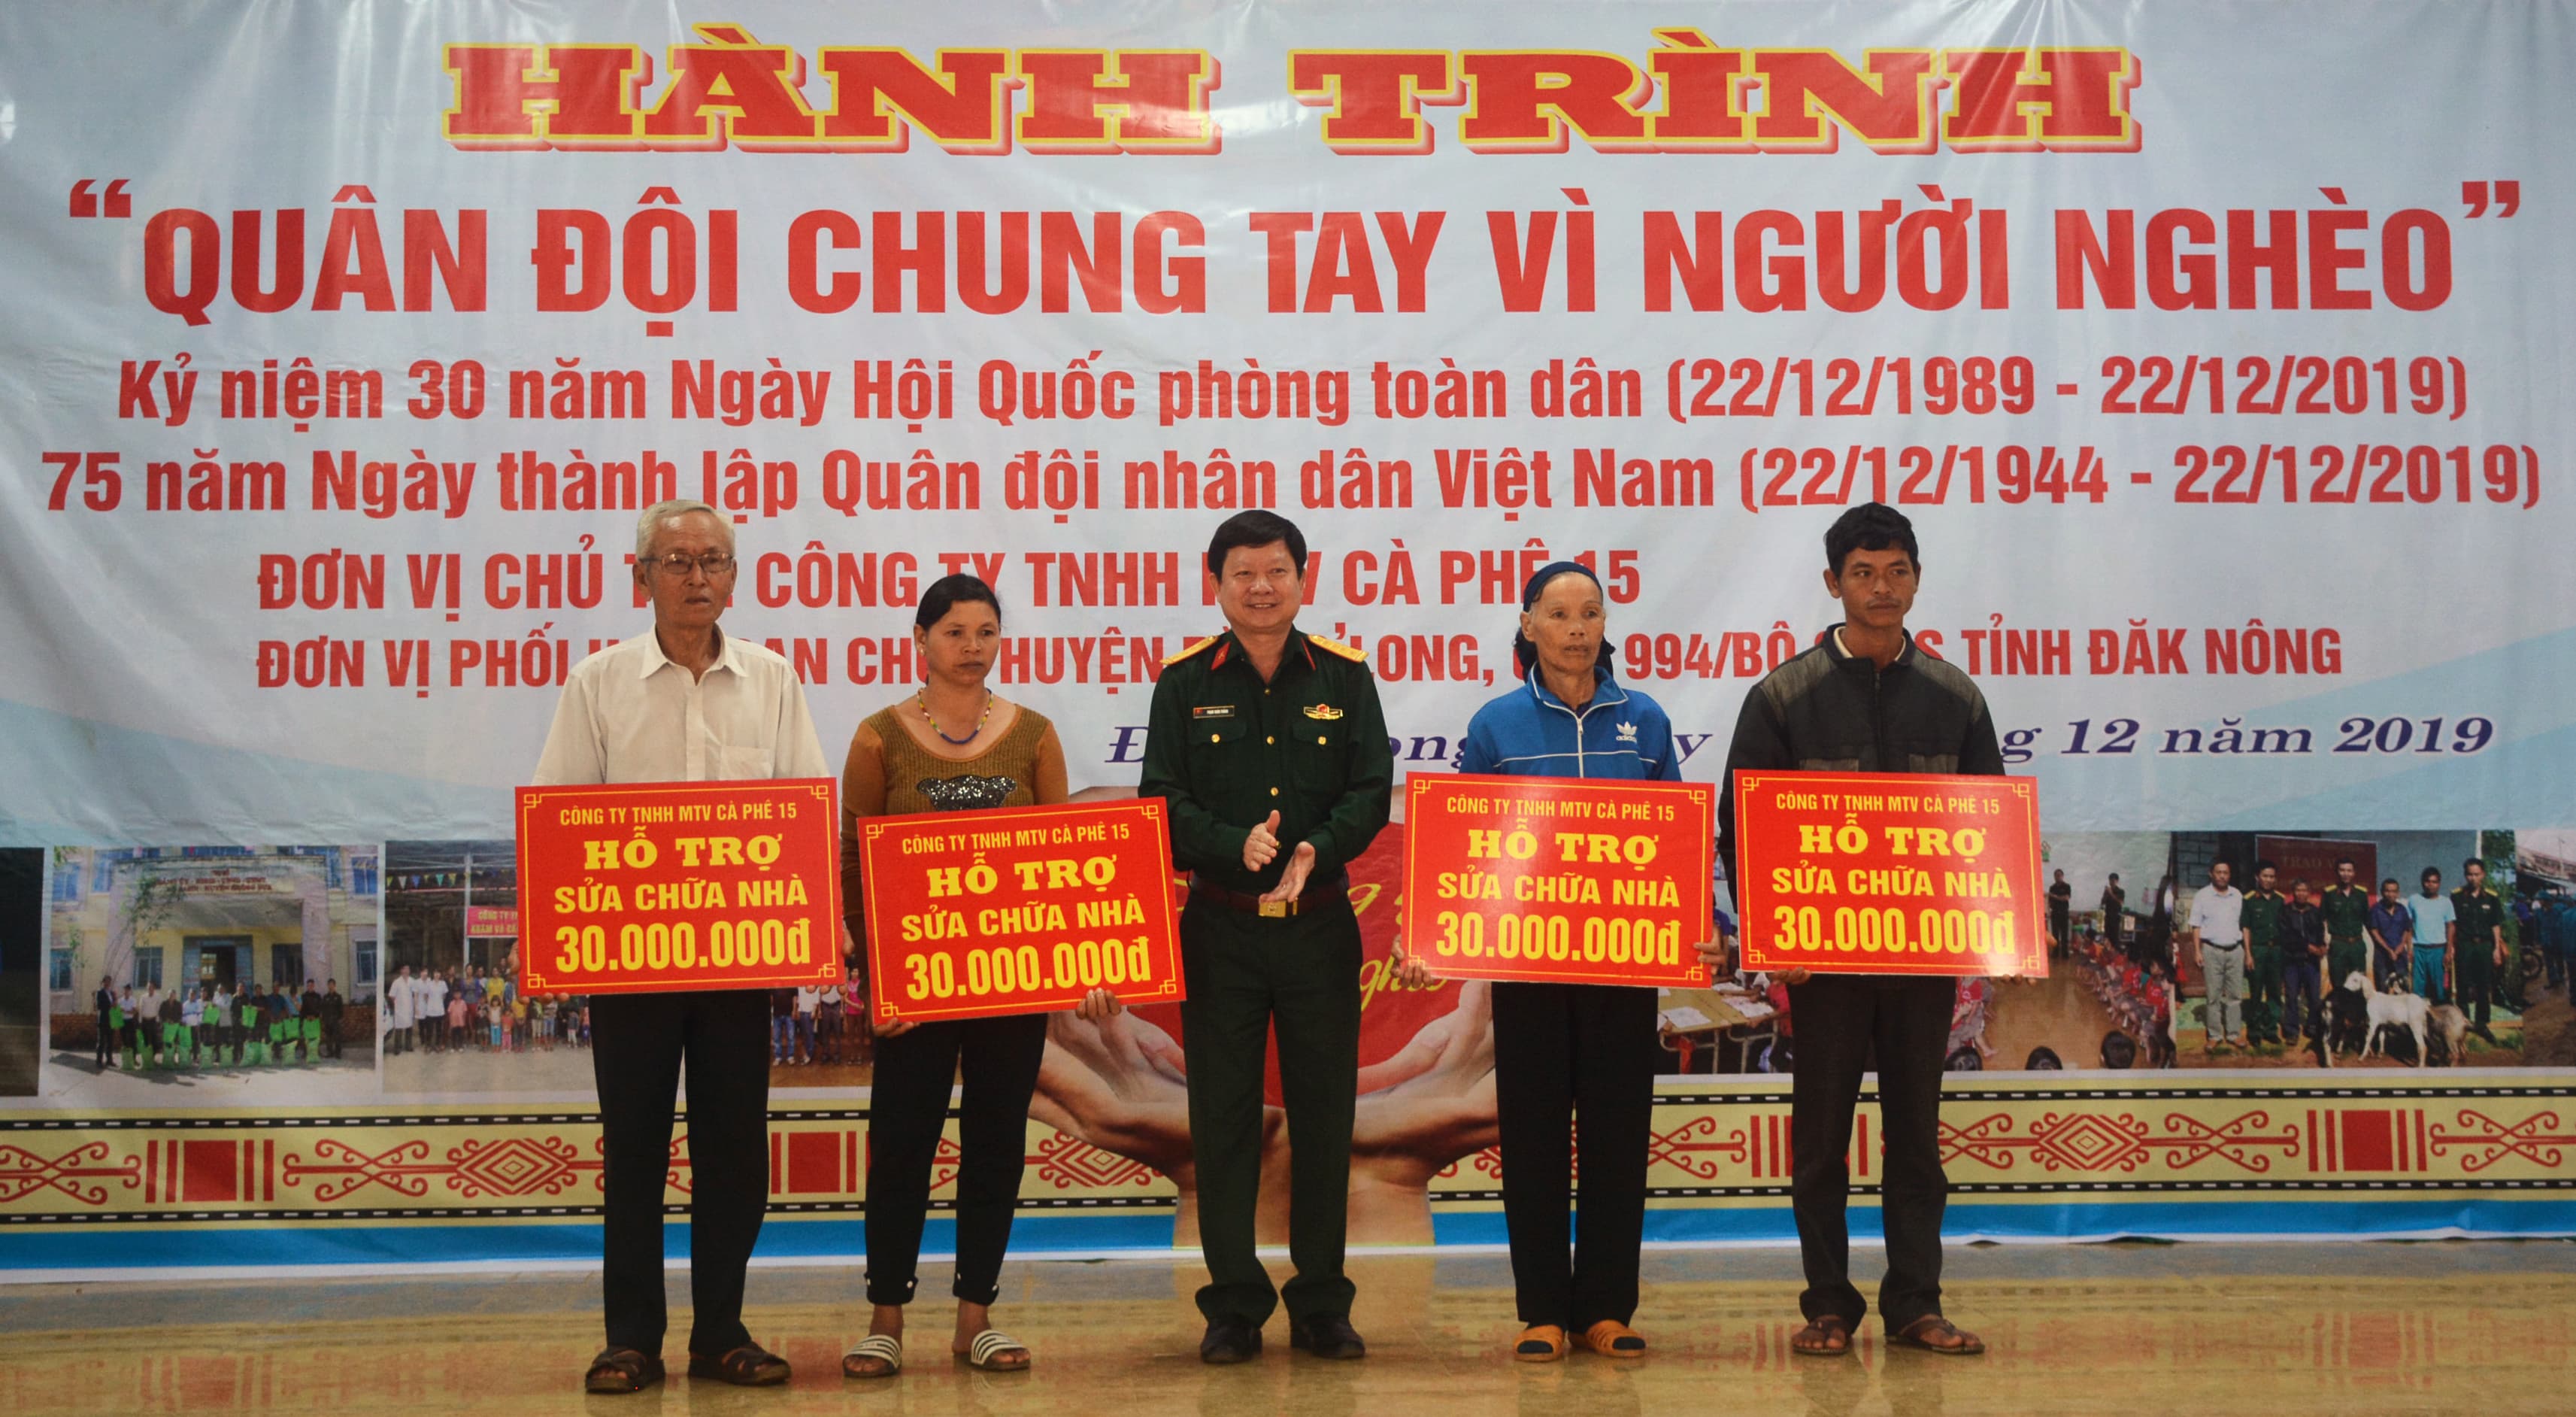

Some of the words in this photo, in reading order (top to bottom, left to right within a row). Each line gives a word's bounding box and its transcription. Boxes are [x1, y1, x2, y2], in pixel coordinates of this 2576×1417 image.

[441, 23, 1221, 156] HÀNH
[1286, 26, 2143, 155] TRÌNH
[70, 180, 487, 326] “QUÂN
[531, 187, 738, 337] ĐỘI
[788, 209, 1206, 315] CHUNG
[1250, 211, 1446, 313] TAY
[1487, 188, 1596, 312] VÌ
[1644, 184, 2009, 313] NGƯỜI
[2055, 181, 2520, 311] NGHÈO”
[120, 352, 198, 426] Kỷ
[221, 357, 383, 432] niệm
[408, 360, 485, 420] 30
[510, 357, 646, 420] năm
[672, 357, 831, 426] Ngày
[854, 358, 953, 433] Hội
[979, 350, 1135, 426] Quốc
[1159, 358, 1350, 426] phòng
[1371, 357, 1507, 419] toàn
[1531, 357, 1641, 418] dân
[1668, 356, 2035, 423] (22/12/1989
[2057, 384, 2078, 395] -
[2102, 355, 2466, 420] 22/12/2019)
[43, 452, 122, 511] 75
[147, 448, 286, 511] năm
[313, 449, 476, 519] Ngày
[497, 449, 677, 511] thành
[697, 448, 798, 529] lập
[823, 449, 980, 517] Quân
[1005, 448, 1099, 523] đội
[1125, 448, 1276, 509] nhân
[1301, 448, 1413, 509] dân
[1435, 447, 1552, 522] Việt
[1574, 448, 1714, 507] Nam
[1741, 445, 2109, 513] (22/12/1944
[2131, 472, 2152, 484] -
[2174, 445, 2539, 508] 22/12/2019)
[257, 548, 385, 610] ĐƠN
[408, 554, 461, 622] VỊ
[485, 534, 603, 610] CHỦ
[756, 540, 918, 608] CÔNG
[1025, 552, 1179, 607] TNHH
[1343, 539, 1420, 606] CÀ
[256, 635, 365, 688] ĐƠN
[384, 639, 430, 698] VỊ
[450, 622, 568, 687] PHỐI
[996, 621, 1165, 694] HUYỆN
[1961, 614, 2071, 675] TỈNH
[2088, 619, 2188, 675] ĐĂK
[2206, 619, 2341, 675] NÔNG
[2062, 719, 2139, 753] 12
[2164, 718, 2311, 753] năm
[2334, 718, 2492, 752] 2019
[561, 809, 603, 824] CÔNG
[610, 809, 626, 823] TY
[633, 806, 673, 822] TNHH
[680, 806, 711, 821] MTV
[717, 805, 737, 820] CÀ
[744, 803, 772, 819] PHÊ
[779, 803, 796, 818] 15
[1447, 797, 1488, 814] CÔNG
[1494, 799, 1511, 815] TY
[1514, 795, 1555, 821] TNHH
[1561, 802, 1591, 817] MTV
[1597, 803, 1616, 818] CÀ
[1623, 804, 1650, 820] PHÊ
[1658, 806, 1674, 821] 15
[1777, 794, 1817, 809] CÔNG
[1823, 795, 1838, 809] TY
[1844, 796, 1883, 810] TNHH
[1889, 796, 1918, 812] MTV
[1924, 794, 1943, 812] CÀ
[1948, 792, 1979, 815] PHÊ
[1982, 798, 2000, 815] 15
[585, 827, 657, 869] HỖ
[676, 834, 782, 870] TRỢ
[903, 836, 944, 854] CÔNG
[950, 836, 965, 850] TY
[971, 833, 1011, 848] TNHH
[1017, 830, 1046, 845] MTV
[1053, 828, 1072, 843] CÀ
[1077, 825, 1106, 842] PHÊ
[1112, 824, 1129, 839] 15
[1468, 815, 1540, 863] HỖ
[1556, 833, 1659, 870] TRỢ
[1799, 813, 1868, 854] HỖ
[1885, 827, 1988, 866] TRỢ
[556, 878, 623, 912] SỬA
[636, 878, 726, 910] CHỮA
[738, 874, 808, 906] NHÀ
[927, 852, 997, 897] HỖ
[1014, 854, 1117, 891] TRỢ
[1438, 860, 1506, 903] SỬA
[1511, 868, 1600, 906] CHỮA
[1614, 876, 1679, 906] NHÀ
[1773, 860, 1836, 894] SỬA
[1848, 866, 1934, 896] CHỮA
[1945, 864, 2015, 901] NHÀ
[902, 905, 968, 941] SỬA
[979, 902, 1066, 935] CHỮA
[1077, 894, 1144, 927] NHÀ
[1436, 907, 1680, 964] 30.000.000đ
[1774, 902, 2018, 958] 30.000.000đ
[556, 918, 810, 972] 30.000.000đ
[903, 932, 1154, 999] 30.000.000đ
